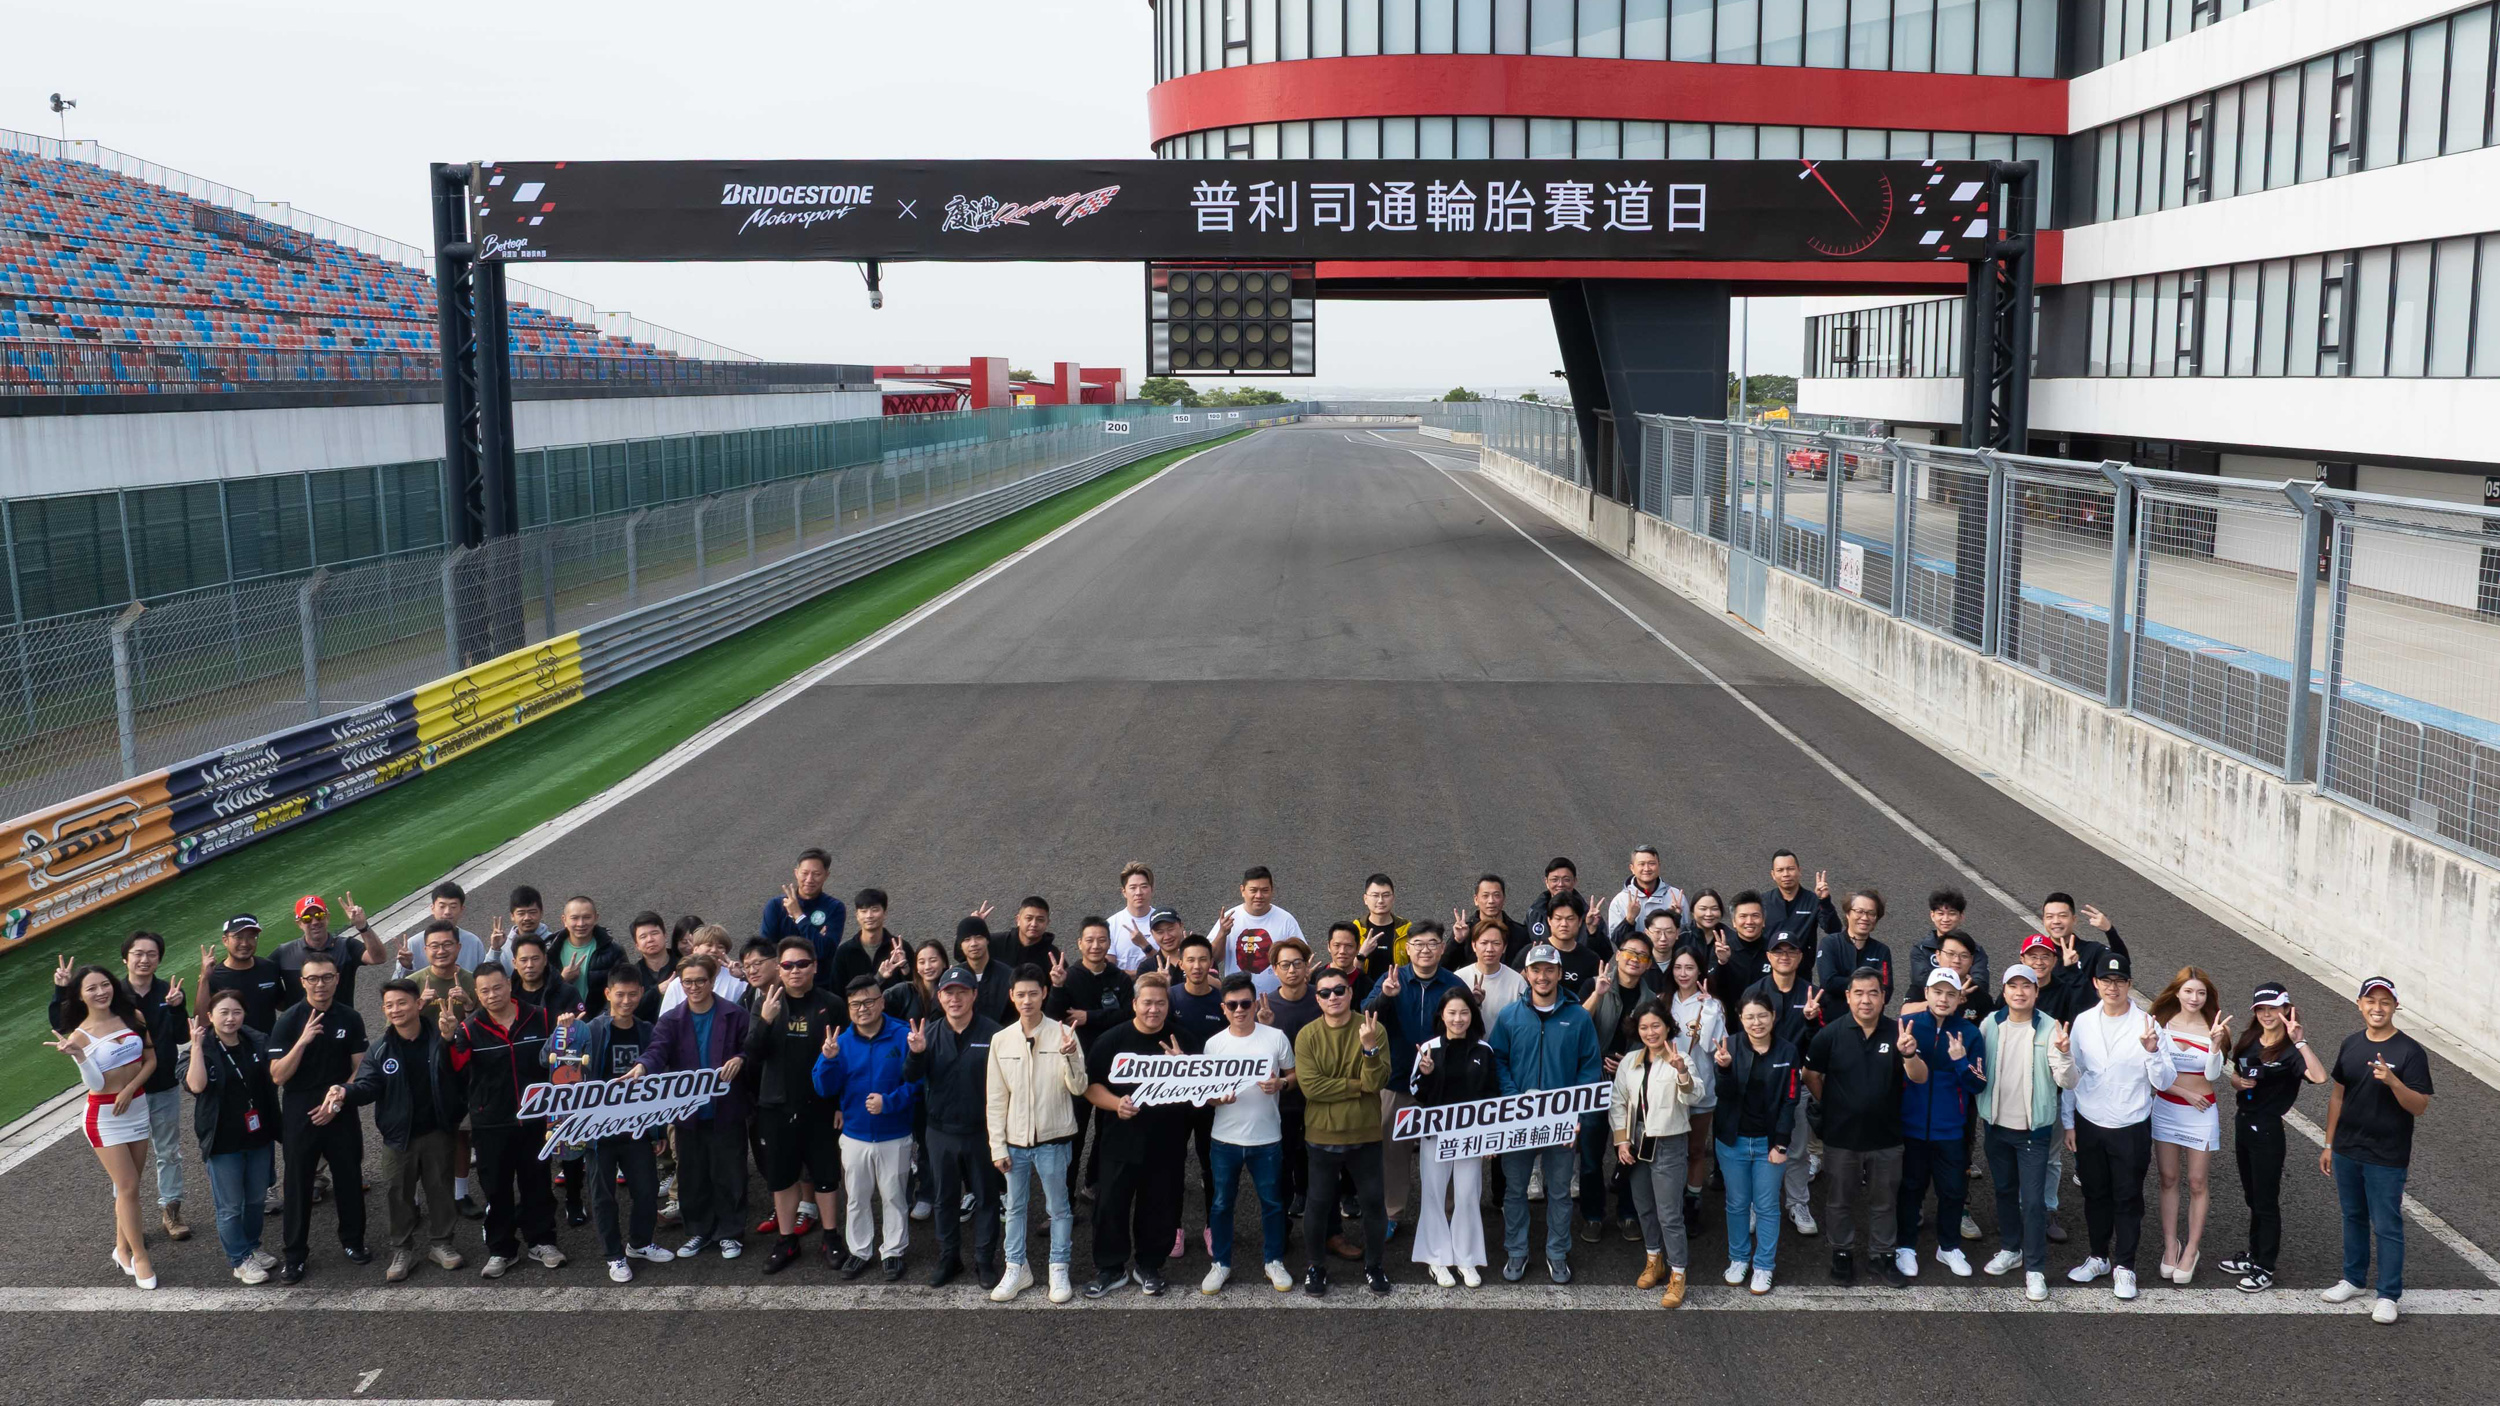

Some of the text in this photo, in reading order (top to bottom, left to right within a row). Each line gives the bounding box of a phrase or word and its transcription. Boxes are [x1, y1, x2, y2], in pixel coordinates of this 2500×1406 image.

[720, 183, 874, 205] BRIDGESTONE
[1190, 179, 1707, 233] 普利司通輪胎賽道日
[738, 206, 856, 236] Motorsport
[1107, 423, 1128, 432] 200
[2316, 465, 2328, 480] 04
[2485, 480, 2500, 498] 05
[341, 739, 392, 772] House
[213, 779, 275, 818] House
[1936, 972, 1955, 981] FILA
[788, 1021, 808, 1032] VIS
[1114, 1058, 1269, 1079] BRIDGESTONE
[519, 1069, 730, 1118] BRIDGESTONE
[1132, 1078, 1251, 1106] Motorsport
[1394, 1083, 1612, 1139] BRIDGESTONE
[542, 1099, 708, 1157] Motorsport
[1438, 1121, 1576, 1160] 普利司通輪胎
